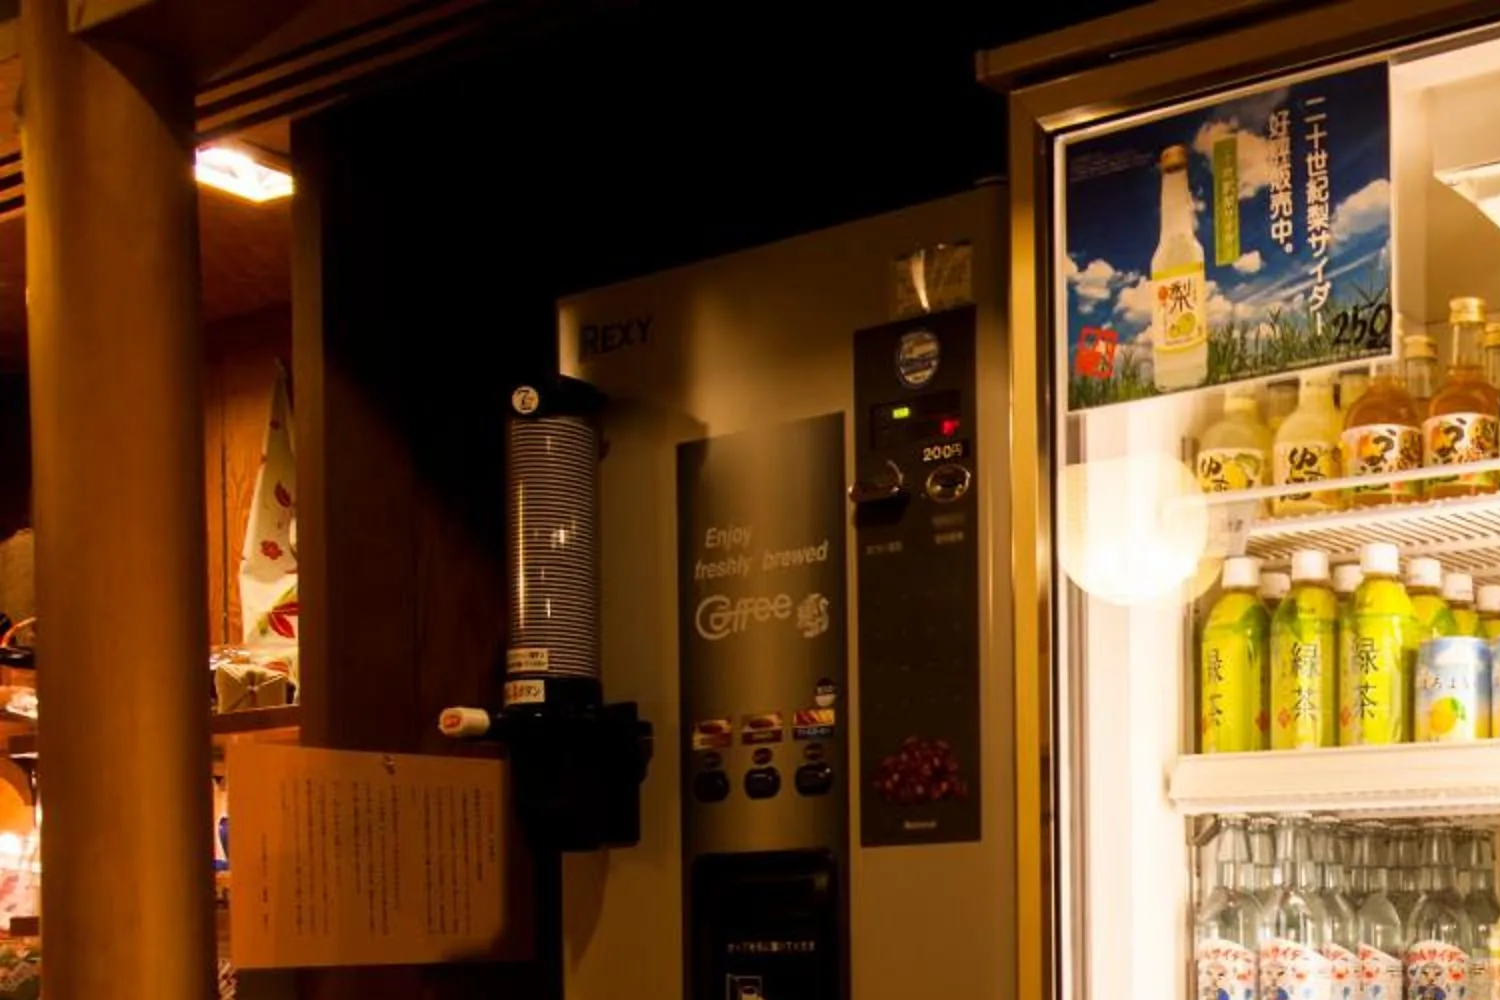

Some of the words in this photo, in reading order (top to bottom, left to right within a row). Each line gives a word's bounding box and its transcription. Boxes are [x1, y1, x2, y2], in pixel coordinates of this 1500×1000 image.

[1304, 96, 1332, 337] 二十世紀梨サイダー
[1168, 278, 1197, 314] 梨
[579, 314, 654, 356] REXY
[694, 555, 750, 580] freshly
[762, 537, 829, 571] brewed
[704, 526, 750, 550] Enjoy
[1290, 640, 1319, 721] 緑茶
